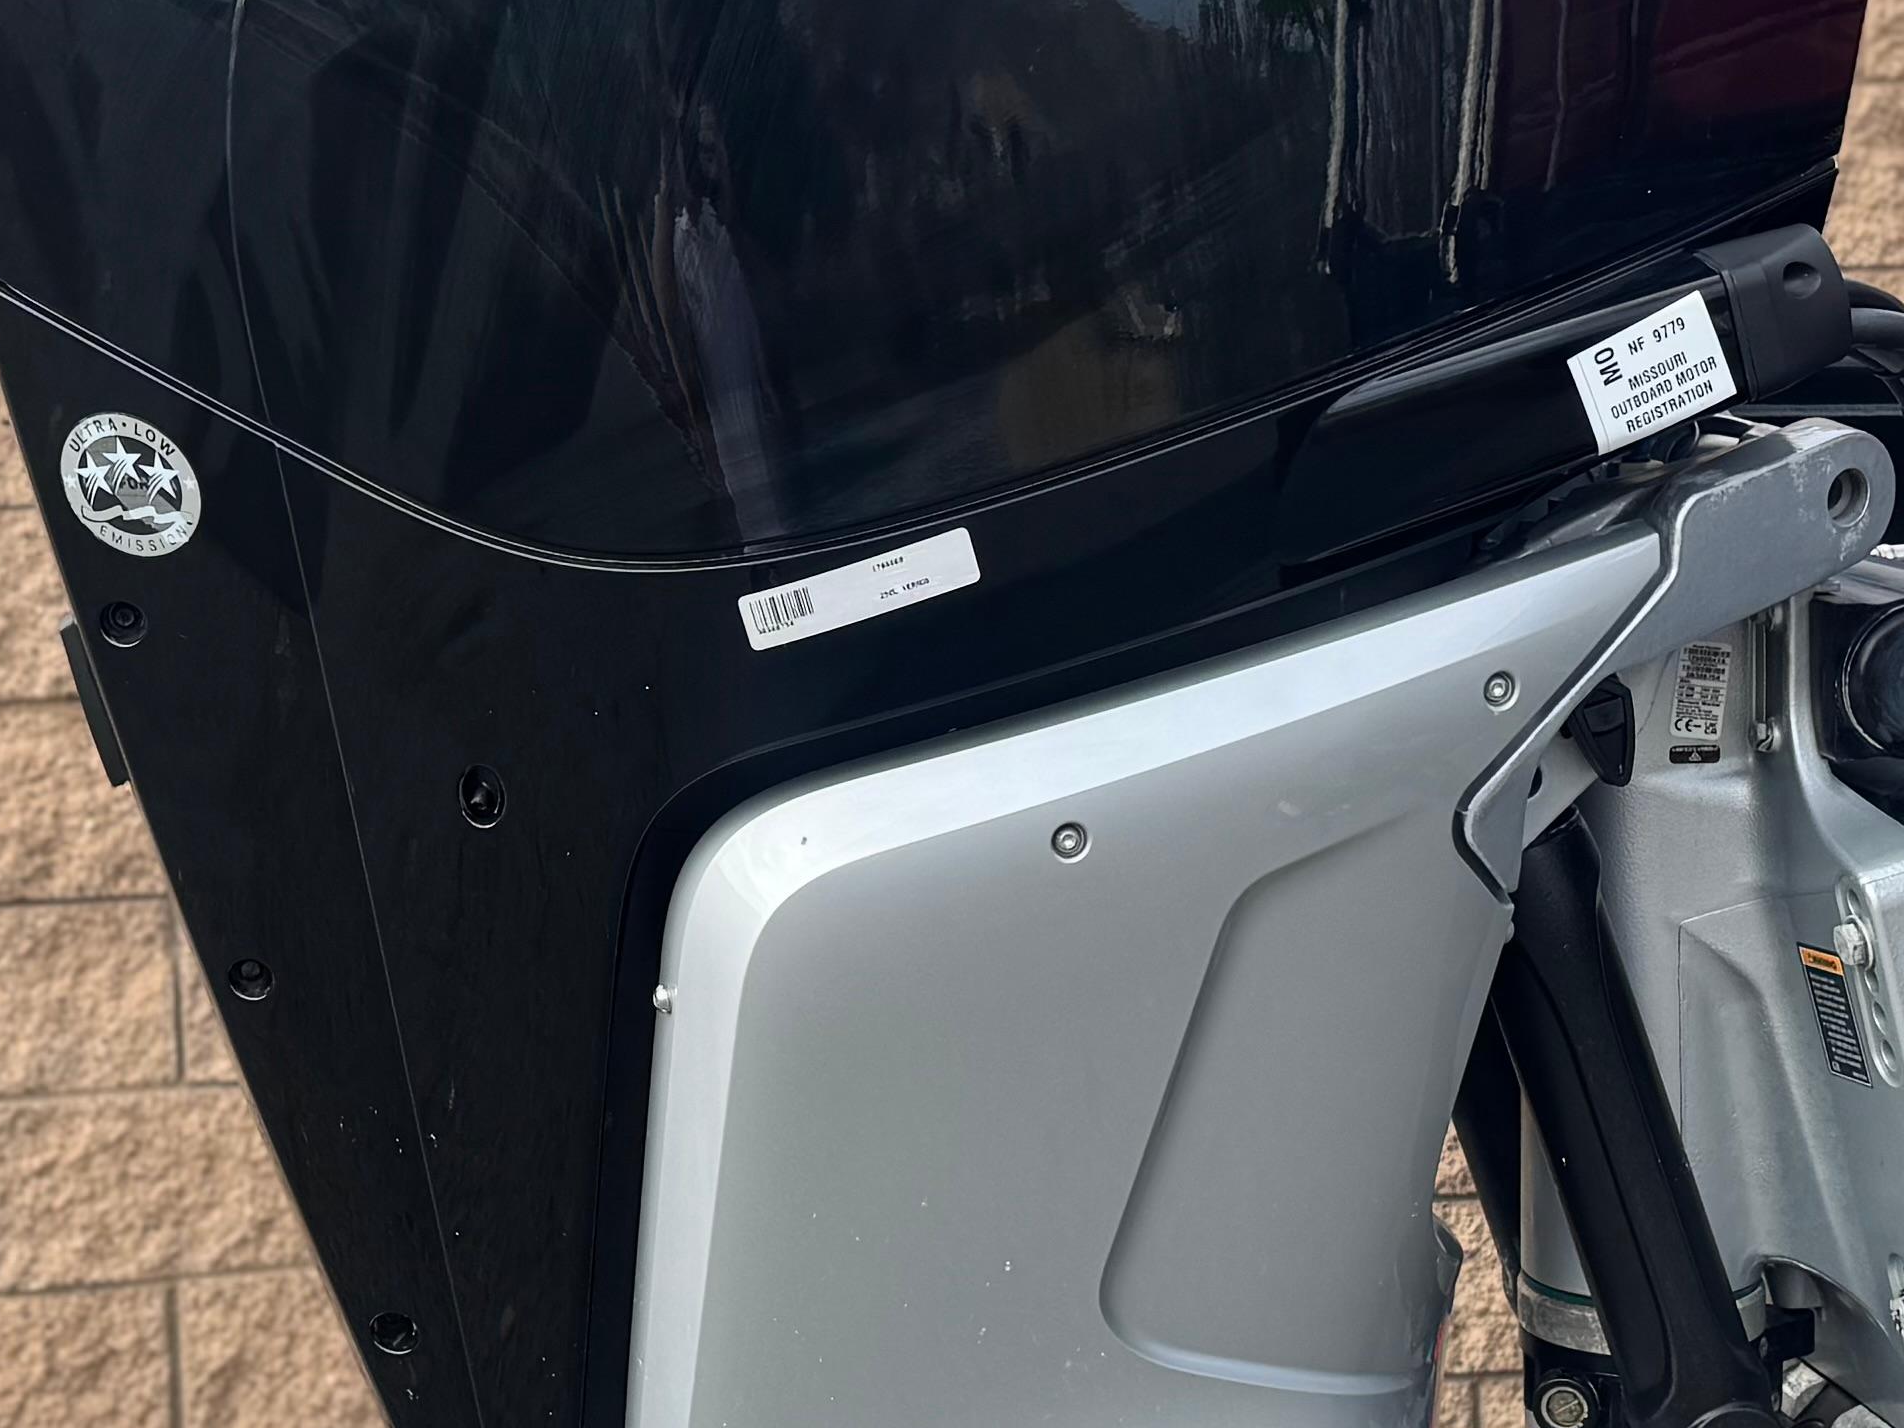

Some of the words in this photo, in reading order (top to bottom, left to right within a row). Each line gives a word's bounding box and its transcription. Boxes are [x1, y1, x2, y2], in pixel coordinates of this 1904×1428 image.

[1628, 337, 1646, 356] NF
[1652, 316, 1686, 343] 9779
[1593, 346, 1623, 386] MO
[1627, 351, 1688, 391] MISSOURI
[1610, 379, 1673, 420] OUTBOARD
[1677, 356, 1718, 387] MOTOR
[1626, 380, 1714, 433] REGISTRATION
[69, 417, 117, 453] ULTRA
[134, 422, 176, 457] LOW
[99, 524, 188, 552] EMISSION
